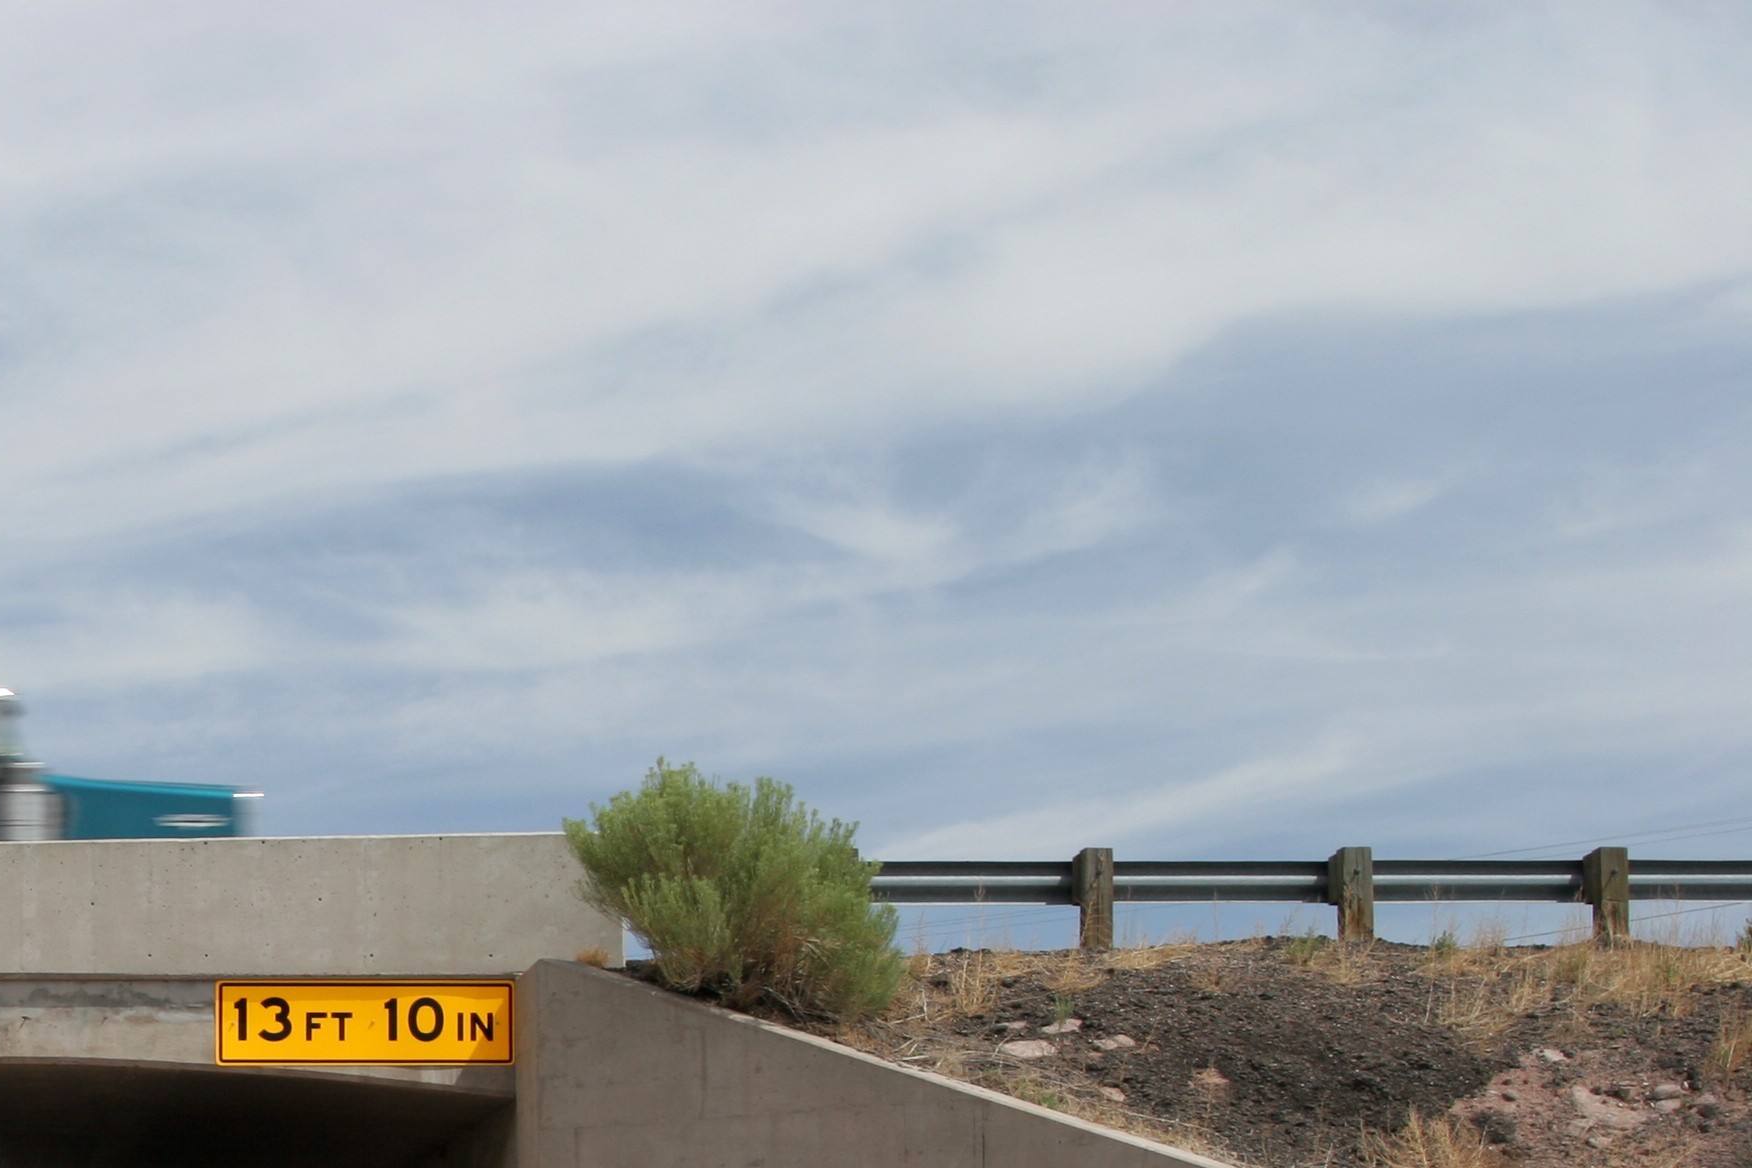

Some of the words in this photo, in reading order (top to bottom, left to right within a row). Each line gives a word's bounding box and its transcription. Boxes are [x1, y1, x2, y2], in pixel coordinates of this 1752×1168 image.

[234, 996, 292, 1042] 13
[306, 1012, 353, 1041] FT
[384, 996, 444, 1042] 10
[457, 1012, 494, 1041] IN
